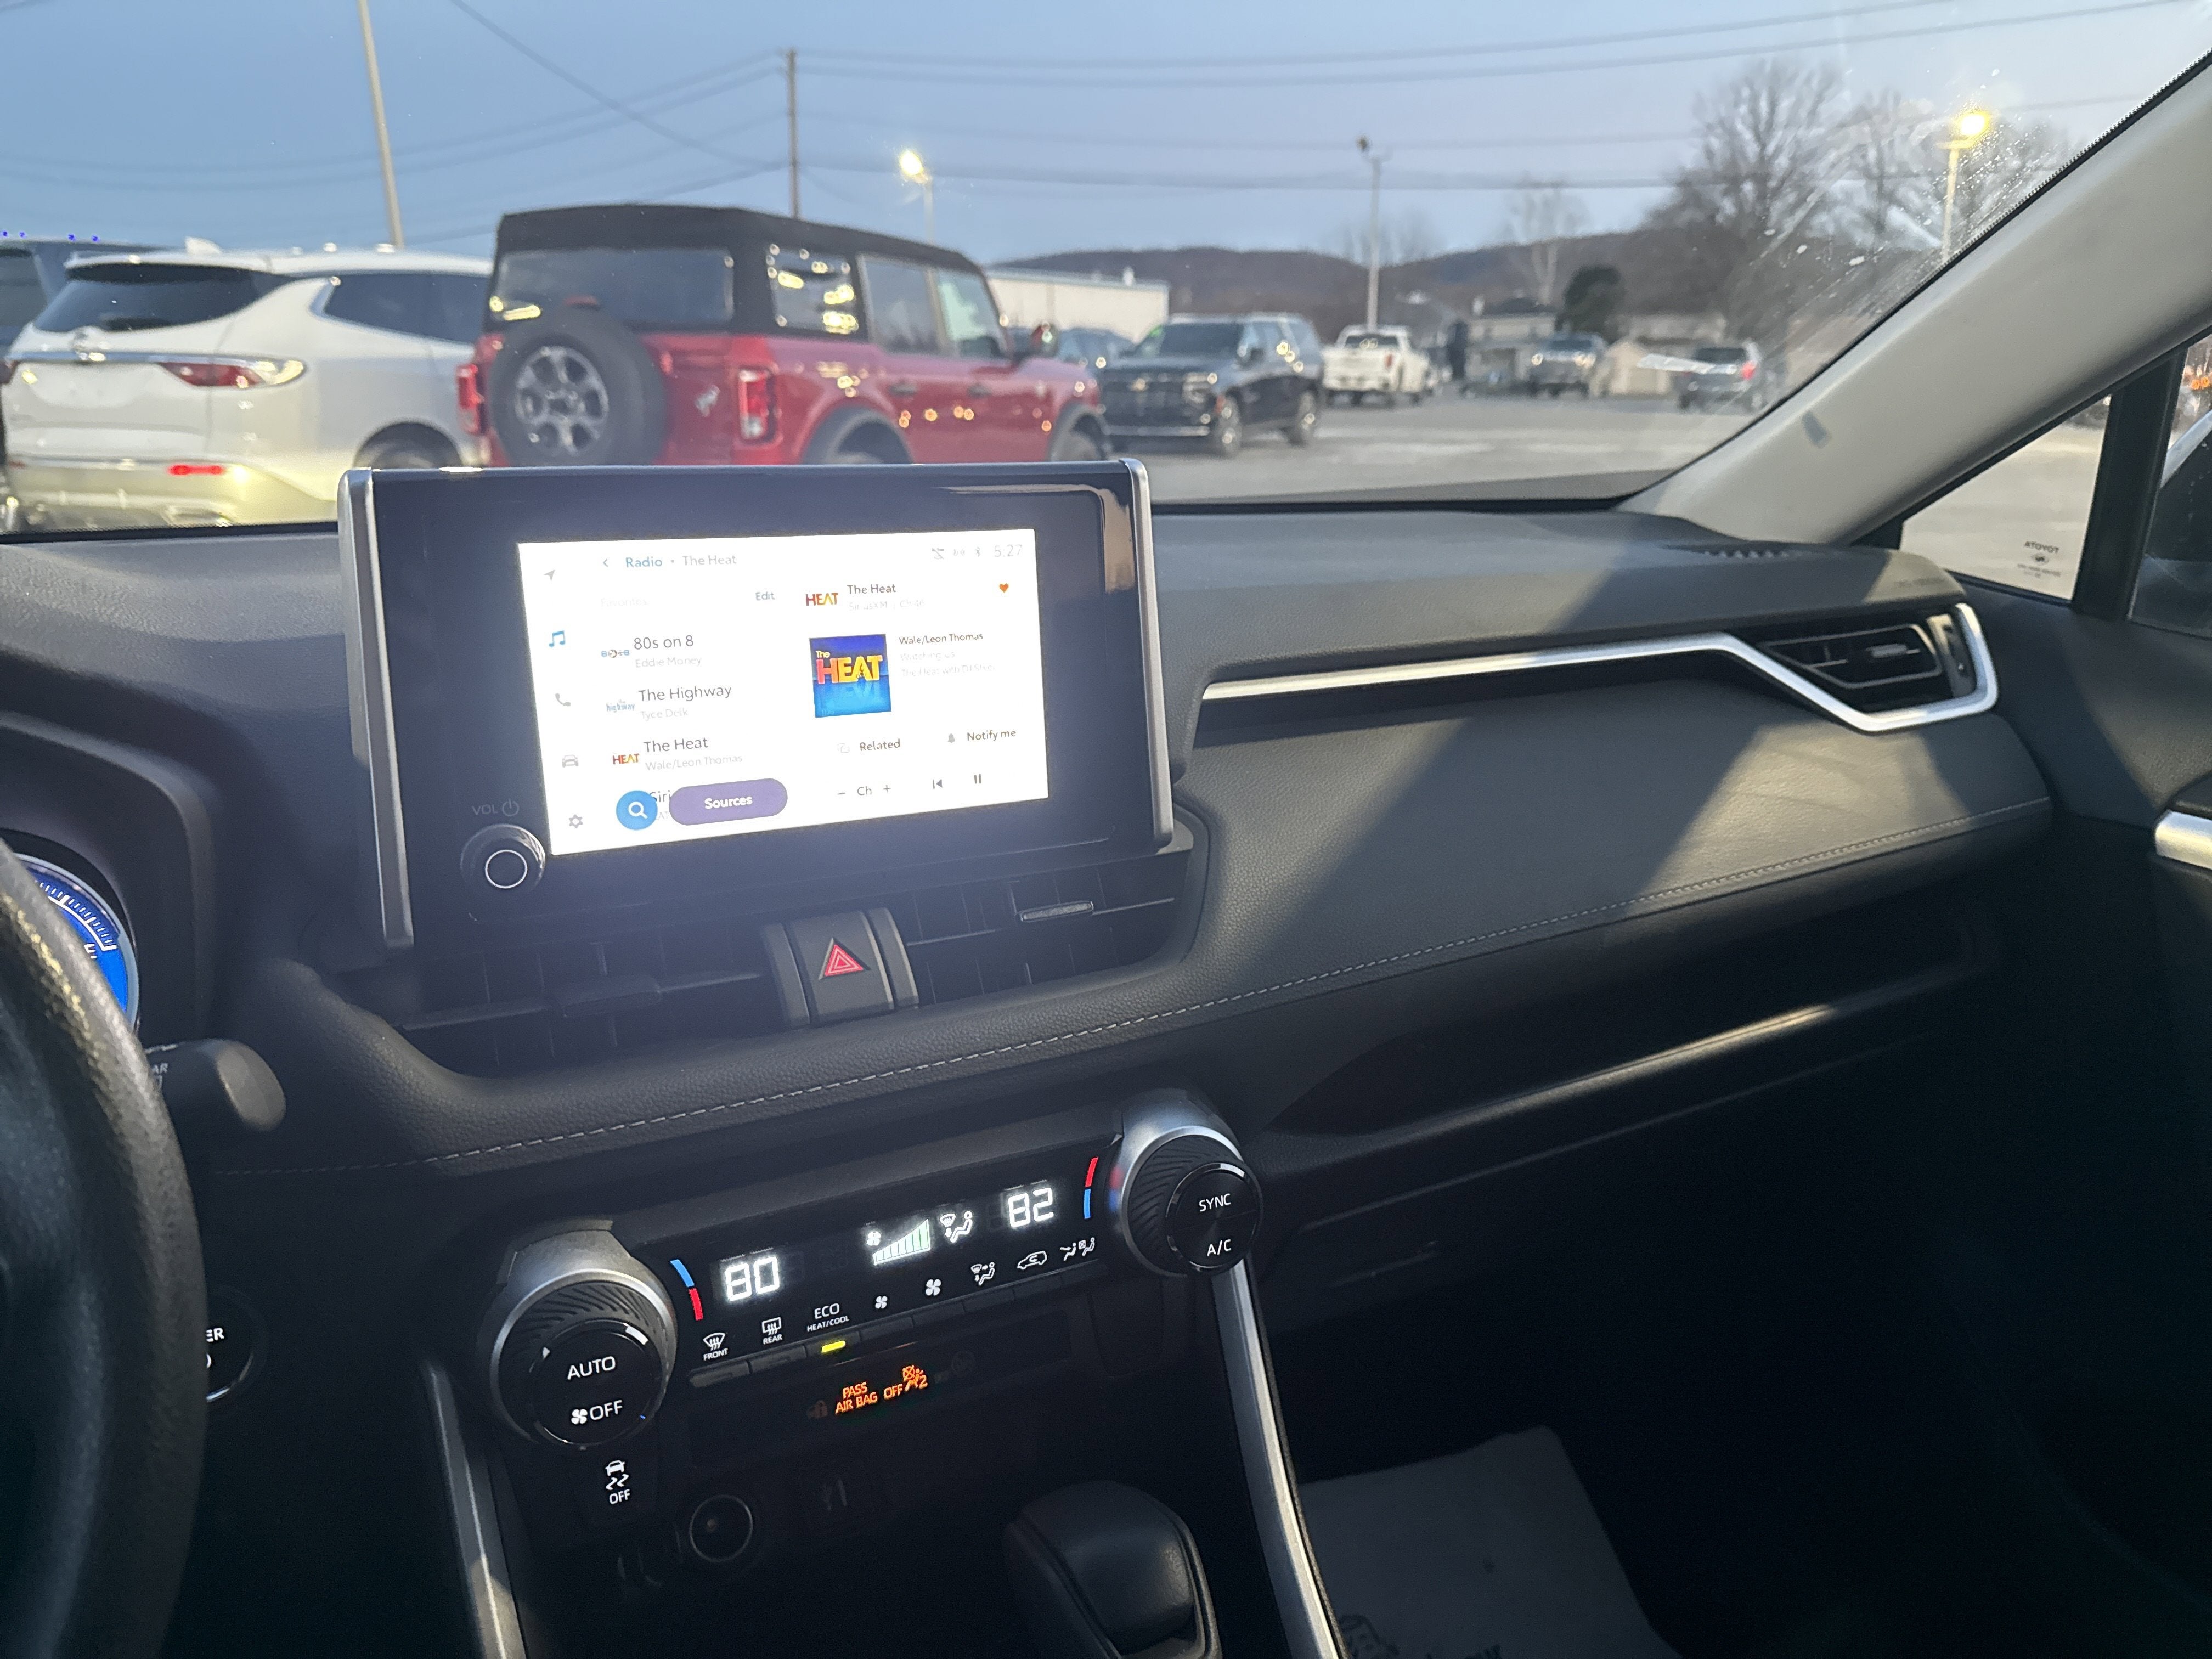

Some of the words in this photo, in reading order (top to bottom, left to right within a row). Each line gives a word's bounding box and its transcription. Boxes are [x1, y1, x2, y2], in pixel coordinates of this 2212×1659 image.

[994, 544, 1022, 558] 5:27
[625, 556, 663, 567] Radio
[682, 556, 704, 566] The
[707, 555, 737, 565] Heat
[755, 591, 775, 601] Edit
[847, 584, 868, 595] The
[871, 583, 896, 594] Heat
[805, 592, 839, 606] HEAT
[634, 637, 659, 650] 80s
[663, 638, 681, 648] on
[685, 635, 694, 647] 8
[899, 635, 947, 645] Wale/Leon
[949, 633, 983, 641] Thomas
[635, 658, 664, 668] Eddie
[667, 657, 702, 667] Money
[816, 655, 883, 684] HEAT
[638, 690, 665, 702] The
[669, 685, 732, 702] Highway
[967, 730, 998, 742] Notify
[644, 741, 670, 753] The
[674, 737, 709, 751] Heat
[860, 739, 901, 752] Related
[612, 753, 640, 765] HEAT
[646, 758, 702, 771] Wale/Leon
[703, 755, 743, 765] Thomas
[857, 786, 872, 796] Ch
[472, 804, 498, 816] VOL
[704, 796, 753, 809] Sources
[1008, 1187, 1054, 1228] 82
[1199, 1193, 1232, 1212] SYNC
[1207, 1239, 1232, 1257] A/C
[725, 1256, 780, 1302] 80
[814, 1303, 840, 1319] ECO
[806, 1315, 850, 1332] HEAT/COOL
[763, 1334, 783, 1345] REAR
[703, 1348, 729, 1361] FRONT
[567, 1356, 616, 1380] AUTO
[842, 1381, 868, 1399] PASS
[835, 1398, 854, 1415] AIR
[855, 1391, 878, 1408] BAG
[883, 1383, 904, 1400] OFF
[589, 1400, 623, 1421] OFF
[609, 1489, 630, 1505] OFF
